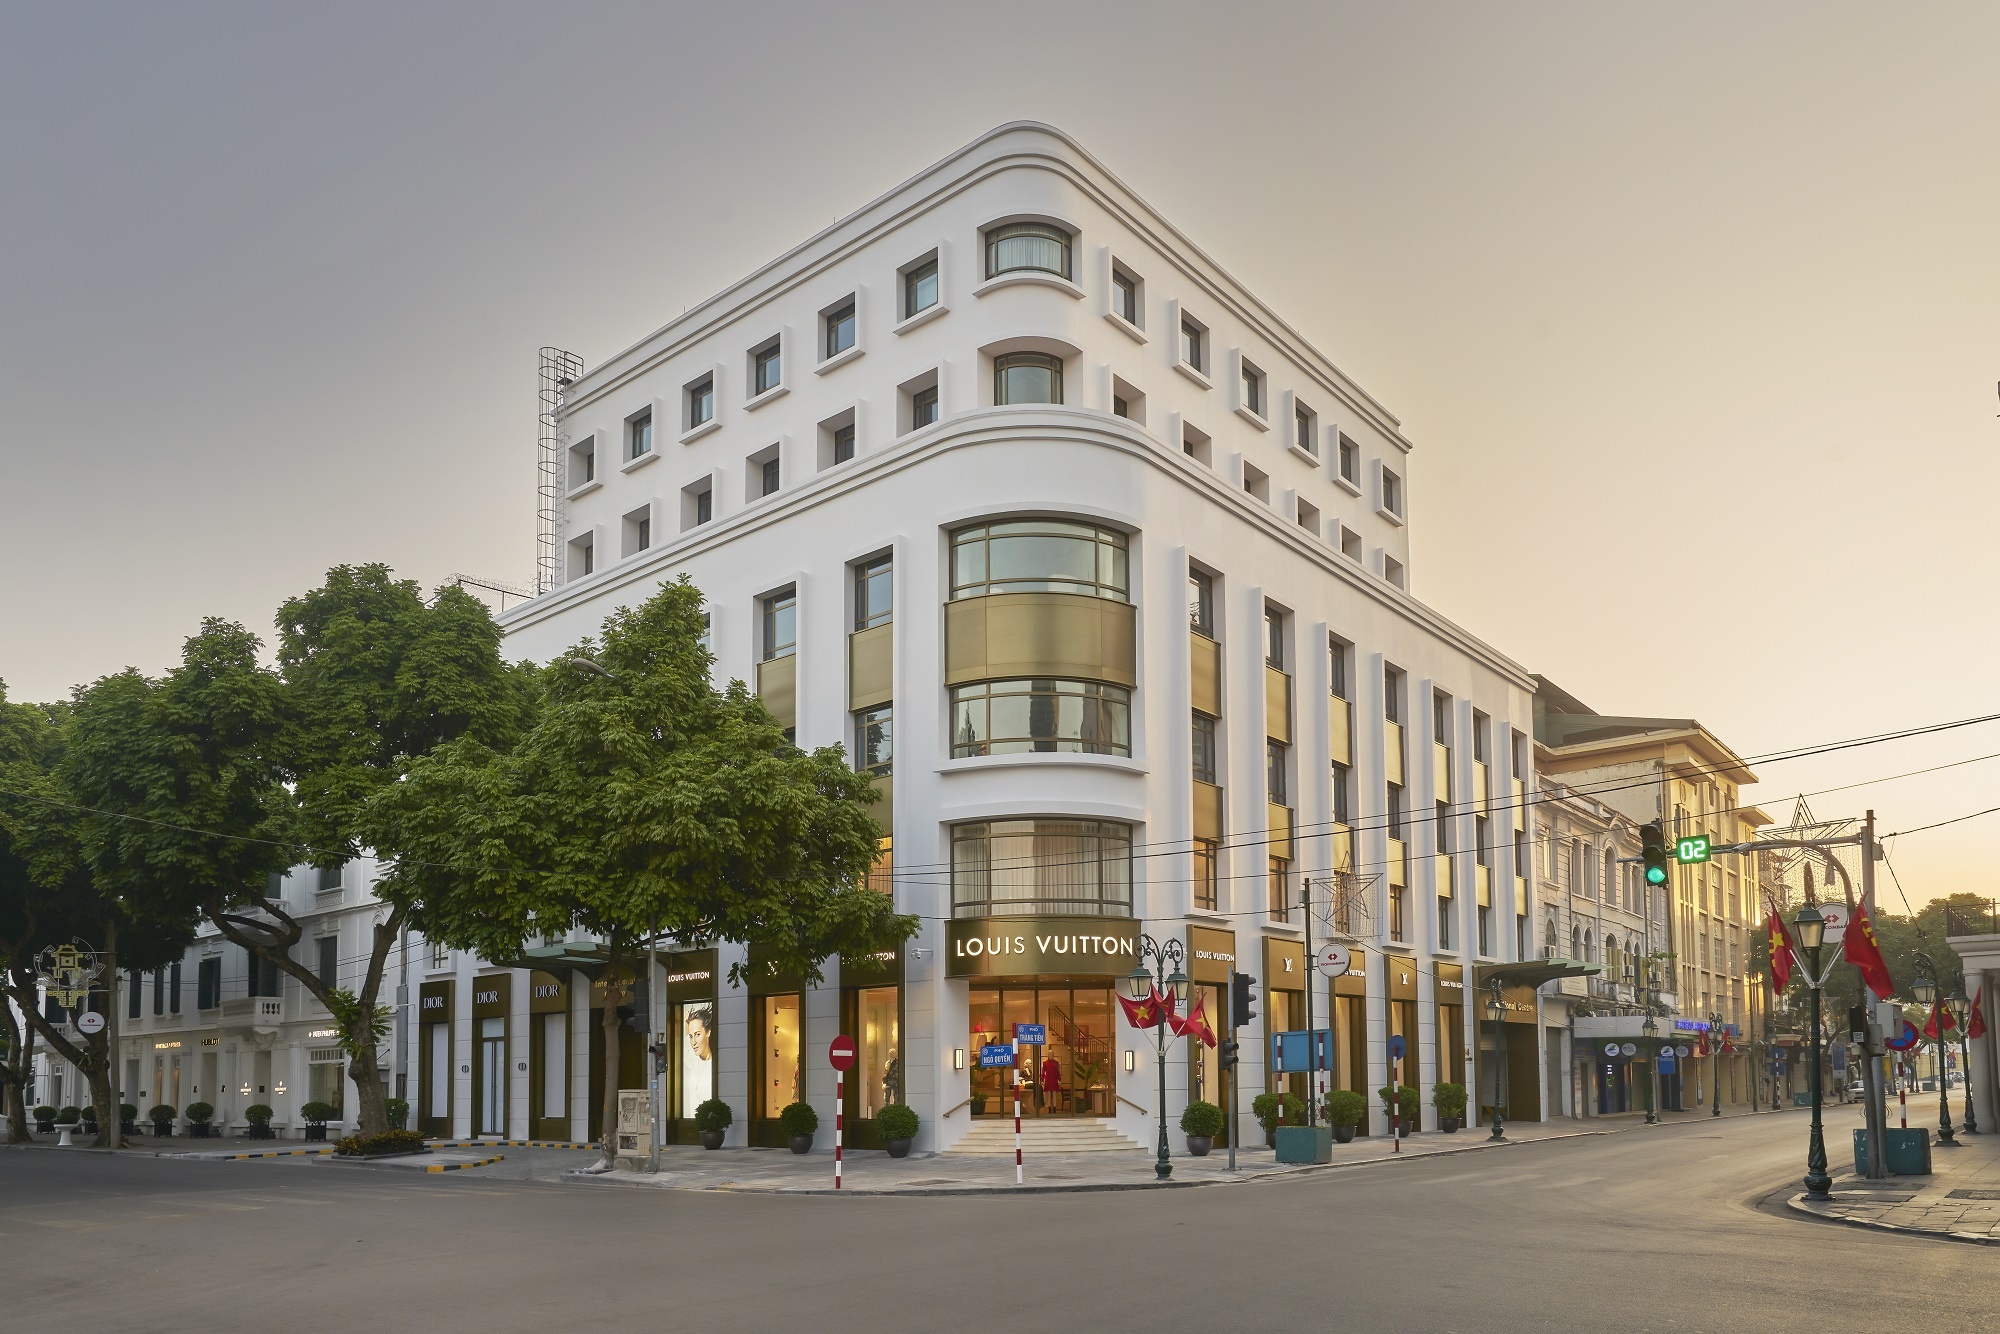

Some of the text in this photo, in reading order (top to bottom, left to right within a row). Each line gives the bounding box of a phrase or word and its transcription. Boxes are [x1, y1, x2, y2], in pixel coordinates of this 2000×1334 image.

[1680, 840, 1706, 860] 02
[957, 935, 1133, 957] LOUIS VUITTON
[1195, 950, 1235, 962] LOUIS VUITTON
[668, 971, 710, 983] LOUIS VUITTON
[477, 990, 498, 1004] DIOR
[535, 984, 559, 998] DIOR
[423, 996, 443, 1009] DIOR
